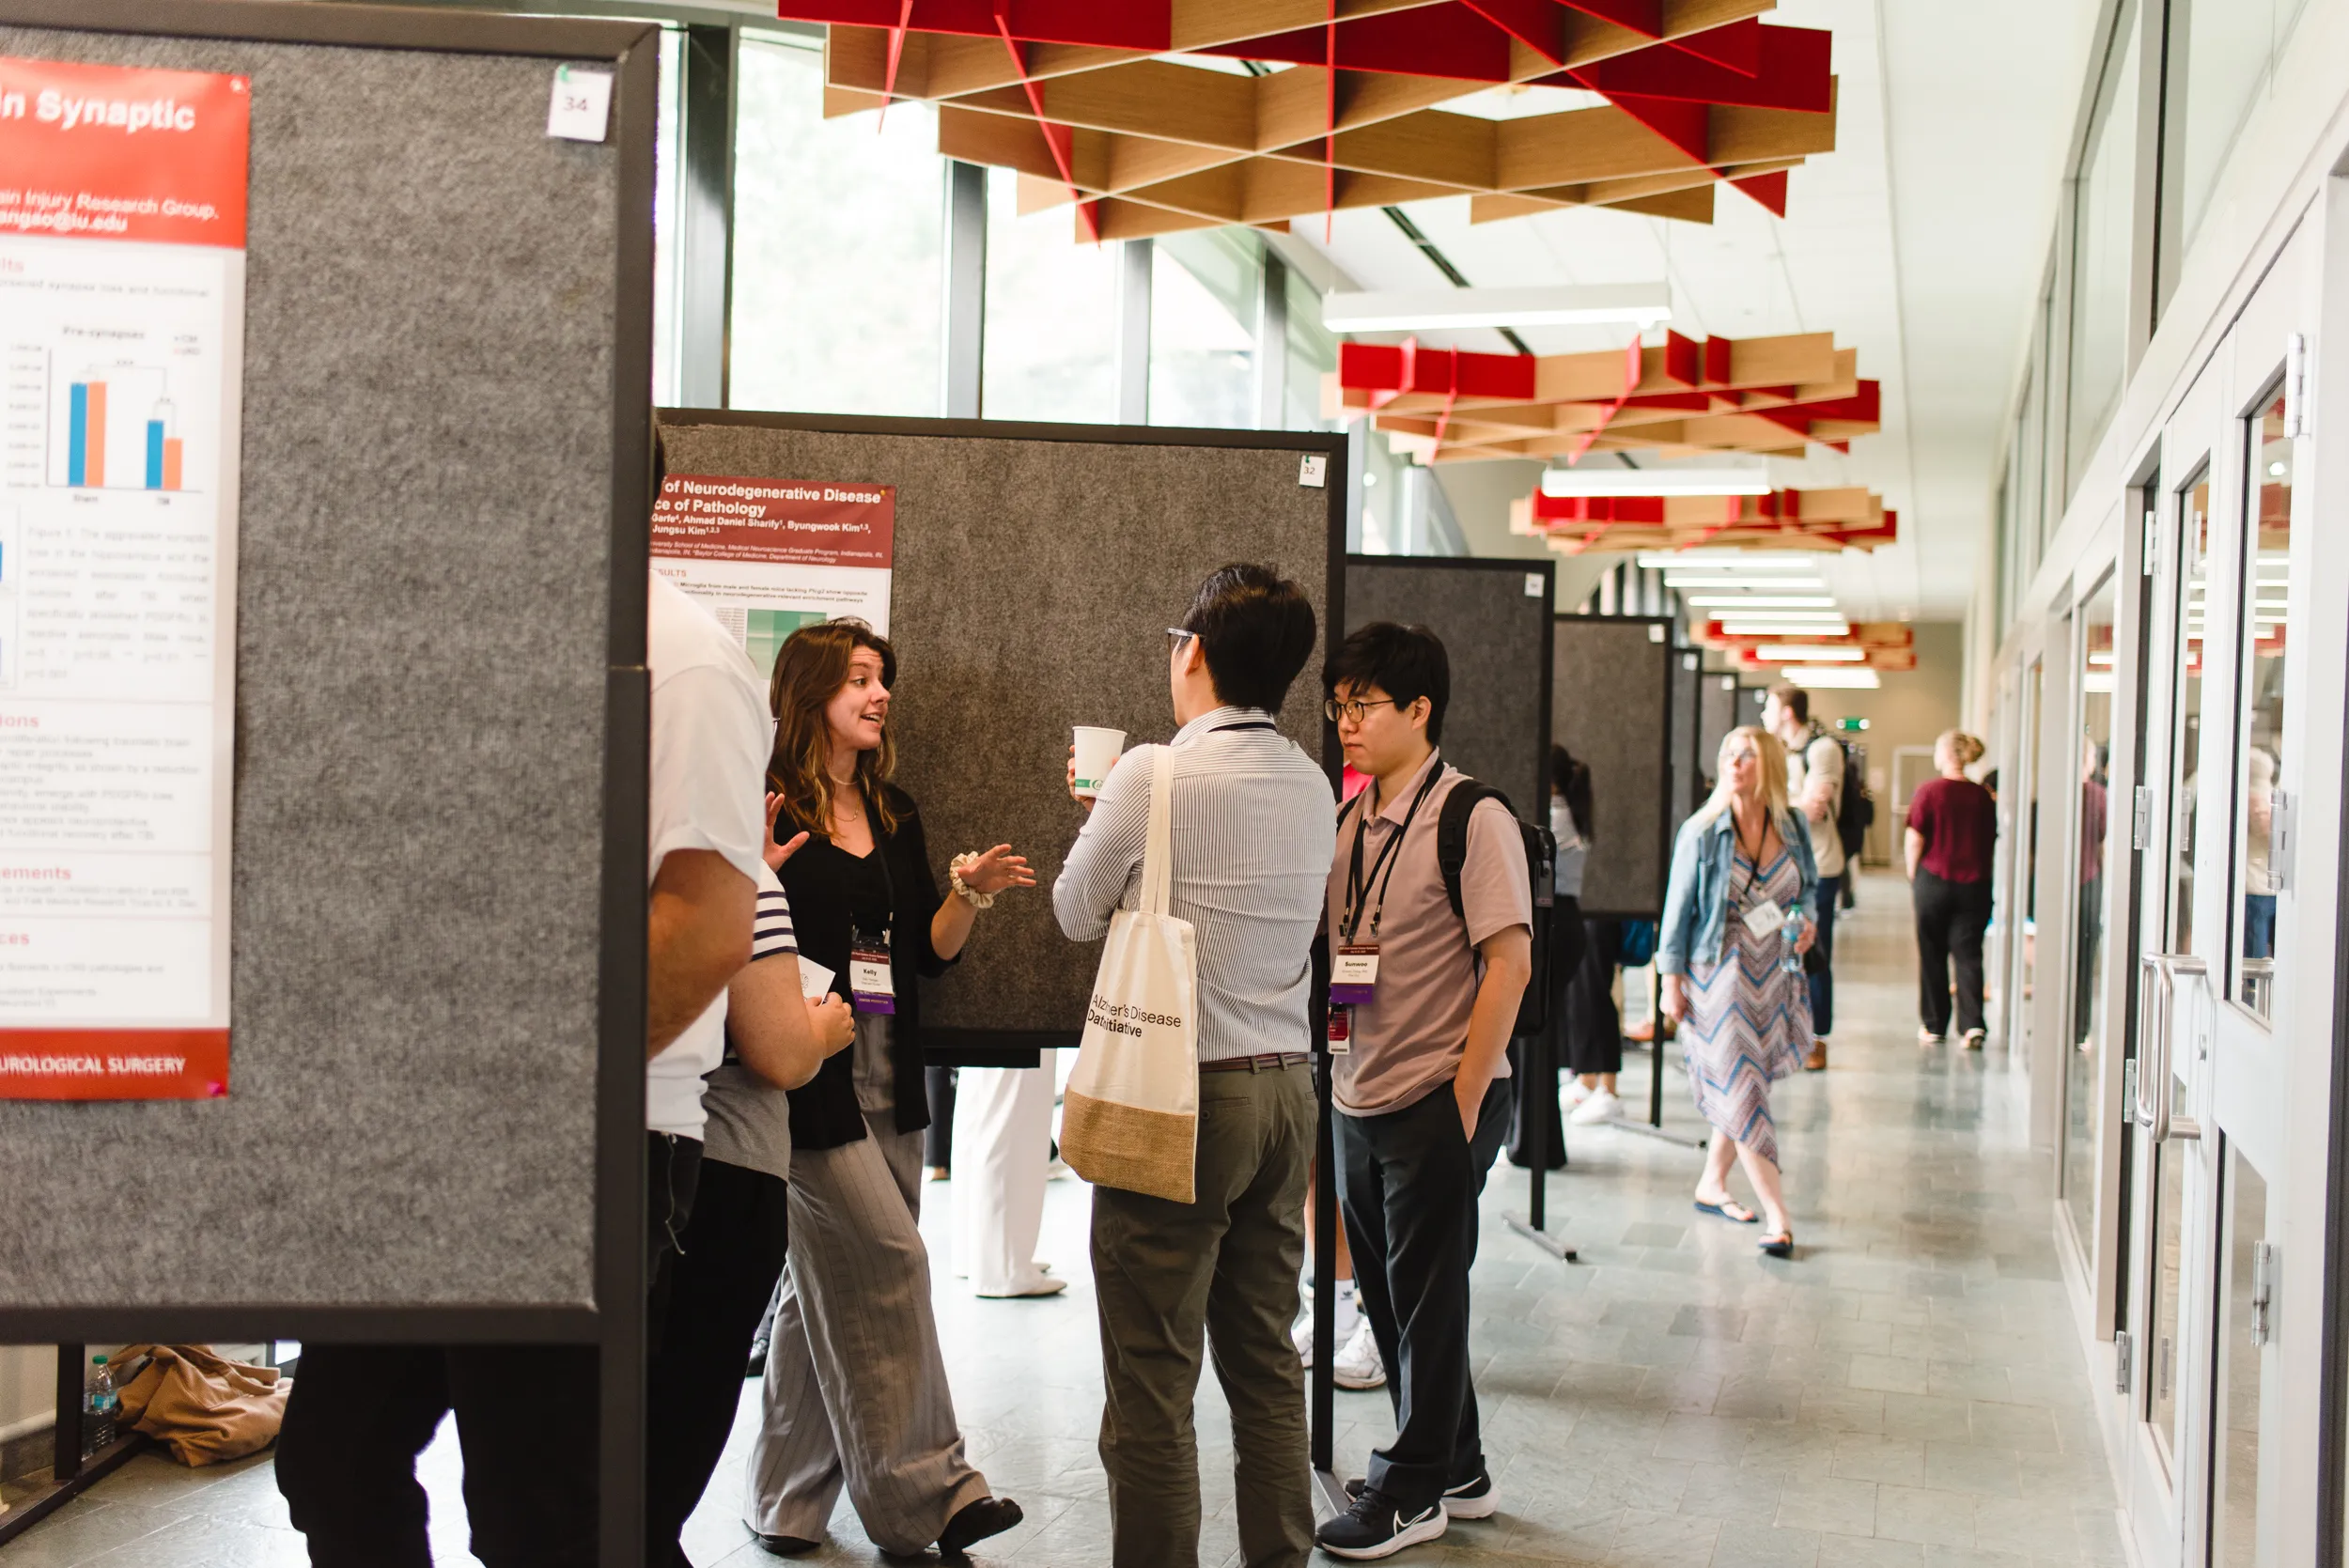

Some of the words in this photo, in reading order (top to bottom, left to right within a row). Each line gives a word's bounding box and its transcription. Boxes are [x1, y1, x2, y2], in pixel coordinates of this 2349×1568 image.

[36, 87, 195, 134] Synaptic
[563, 96, 588, 112] 34
[25, 187, 73, 211] Injury
[77, 192, 158, 214] Research
[1303, 466, 1315, 475] 32
[664, 480, 680, 492] of
[683, 480, 820, 501] Neurodegenerative
[824, 488, 881, 504] Disease
[674, 499, 691, 511] of
[693, 499, 767, 518] Pathology
[652, 525, 686, 536] Jungsu
[683, 515, 715, 525] Ahmad
[717, 517, 745, 527] Daniel
[787, 520, 841, 532] Byungwook
[809, 555, 837, 564] Neurology
[1130, 1006, 1181, 1028] Disease
[107, 1056, 187, 1077] SURGERY
